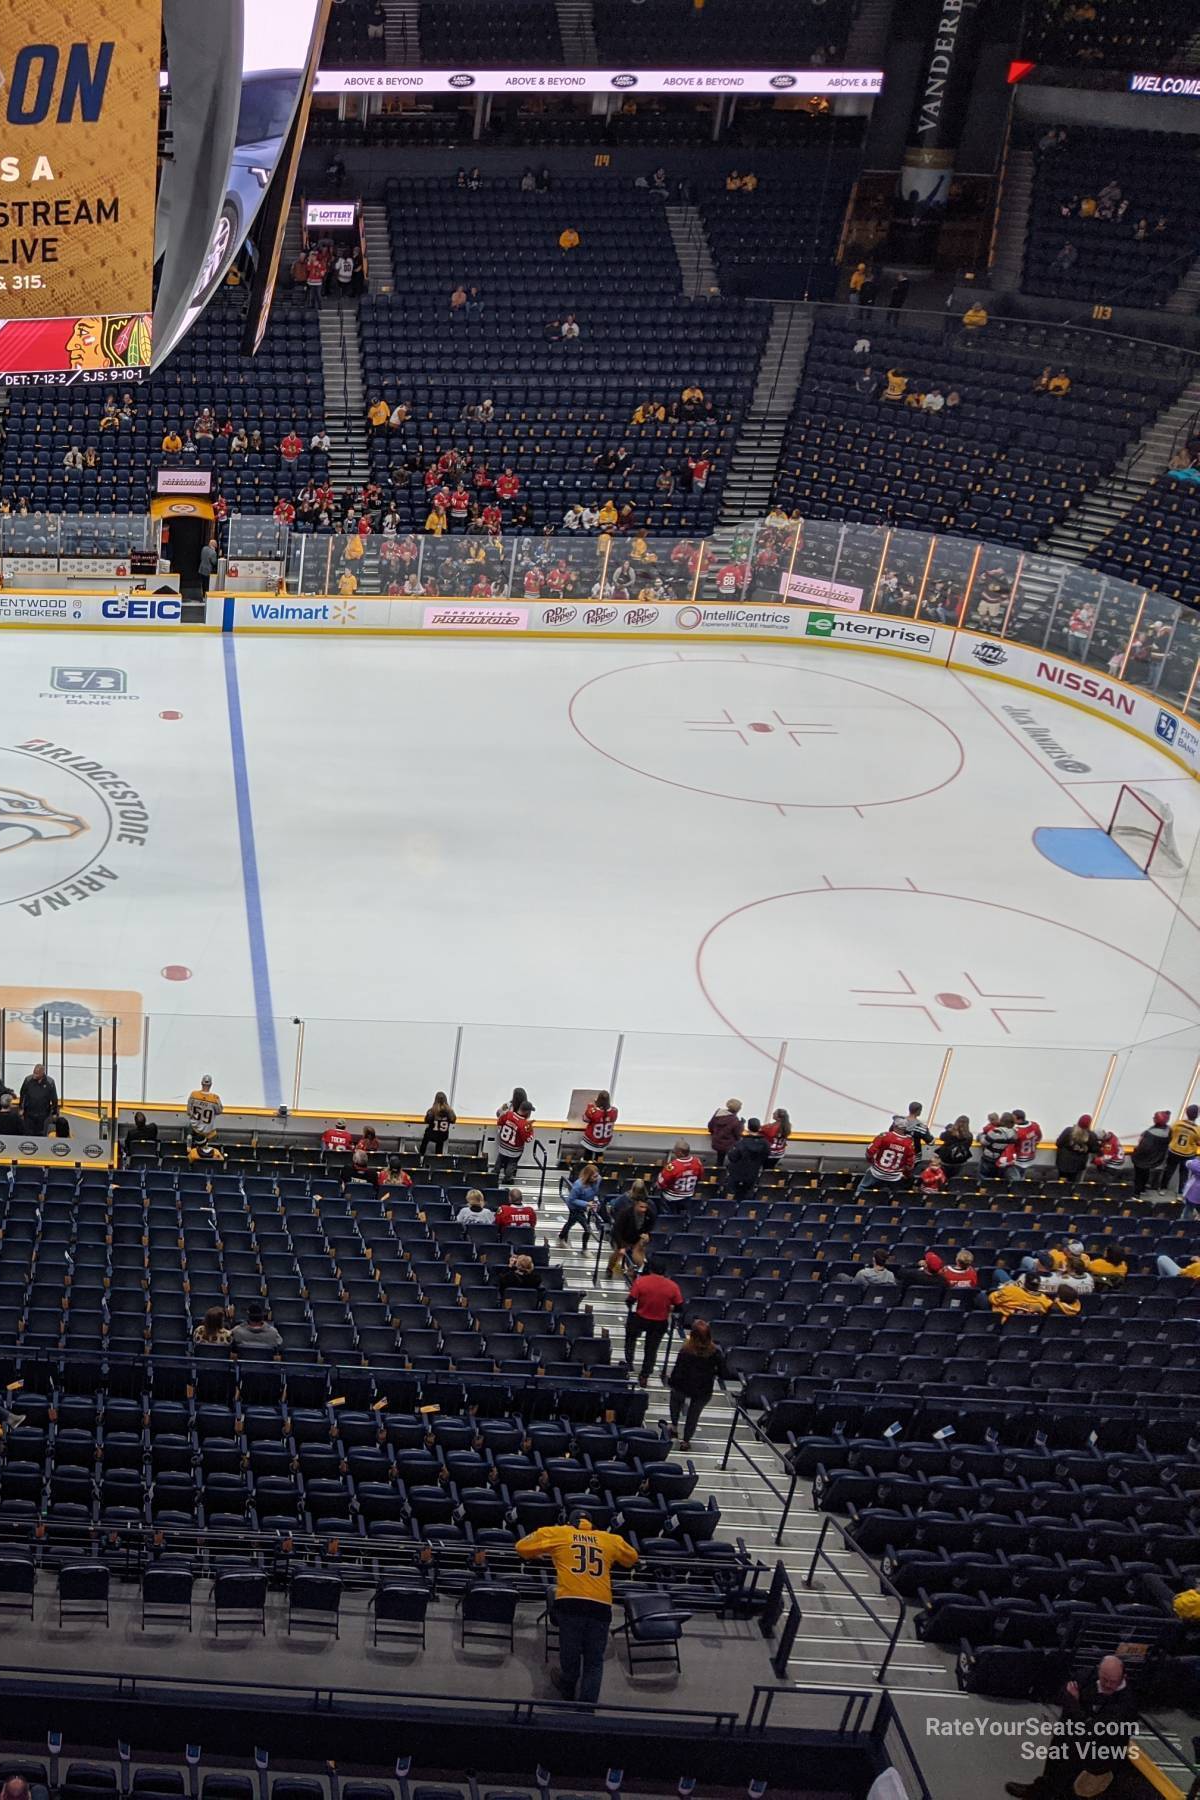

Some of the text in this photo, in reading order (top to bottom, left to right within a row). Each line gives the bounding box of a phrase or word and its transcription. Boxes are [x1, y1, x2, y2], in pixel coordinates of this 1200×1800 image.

[6, 41, 115, 125] ON
[344, 77, 424, 86] ABOVE & BEYOND
[505, 77, 586, 86] ABOVE & BEYOND
[663, 77, 744, 86] ABOVE & BEYOND
[827, 78, 859, 87] ABOVE
[32, 156, 55, 181] A
[320, 211, 352, 219] LOTTERY
[12, 275, 46, 290] 315.
[5, 373, 66, 385] DET: 7-12-2
[83, 370, 142, 382] SJS: 9-10-1
[723, 576, 736, 586] 88
[14, 609, 67, 618] BROKERS
[252, 603, 329, 620] Walmart
[546, 609, 574, 624] Pepper
[586, 609, 615, 625] Pepper
[627, 610, 656, 625] Pepper
[703, 610, 790, 623] IntelliCentrics
[431, 614, 520, 625] PREDATORS
[815, 617, 931, 645] enterprise
[972, 644, 1008, 663] NHL
[63, 671, 115, 689] 5/3
[1036, 662, 1135, 716] NISSAN
[14, 739, 151, 847] BRIDGESTONE
[19, 863, 119, 917] ARENA
[4, 1009, 121, 1028] Pedigree
[192, 1107, 213, 1124] 59
[433, 1121, 448, 1132] 19
[593, 1123, 614, 1139] 88
[500, 1126, 517, 1144] 81
[573, 1534, 598, 1544] RINNE
[570, 1544, 603, 1578] 35
